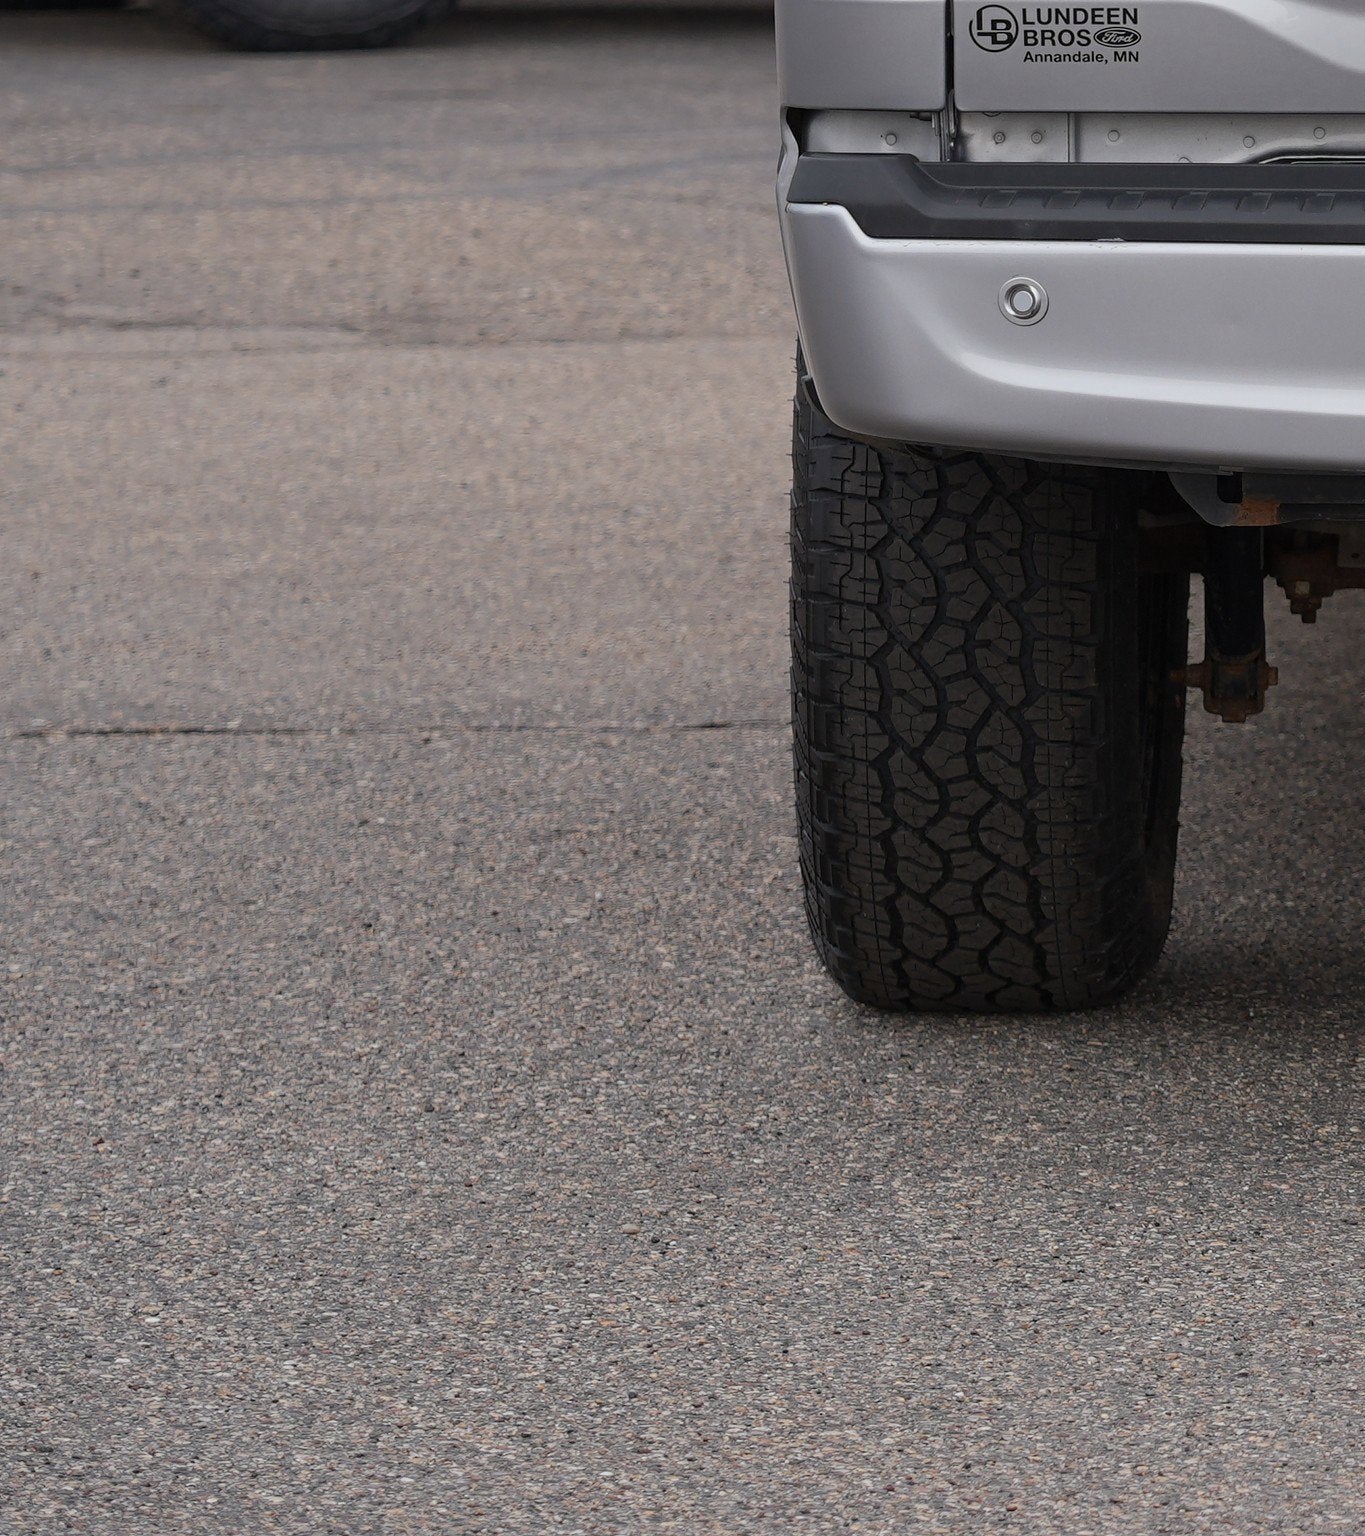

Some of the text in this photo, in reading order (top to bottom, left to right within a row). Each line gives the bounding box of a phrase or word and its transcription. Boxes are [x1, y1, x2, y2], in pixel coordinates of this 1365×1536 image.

[1021, 7, 1139, 26] LUNDEEN
[1023, 28, 1092, 47] BROS
[1023, 50, 1139, 65] Annandale, MN
